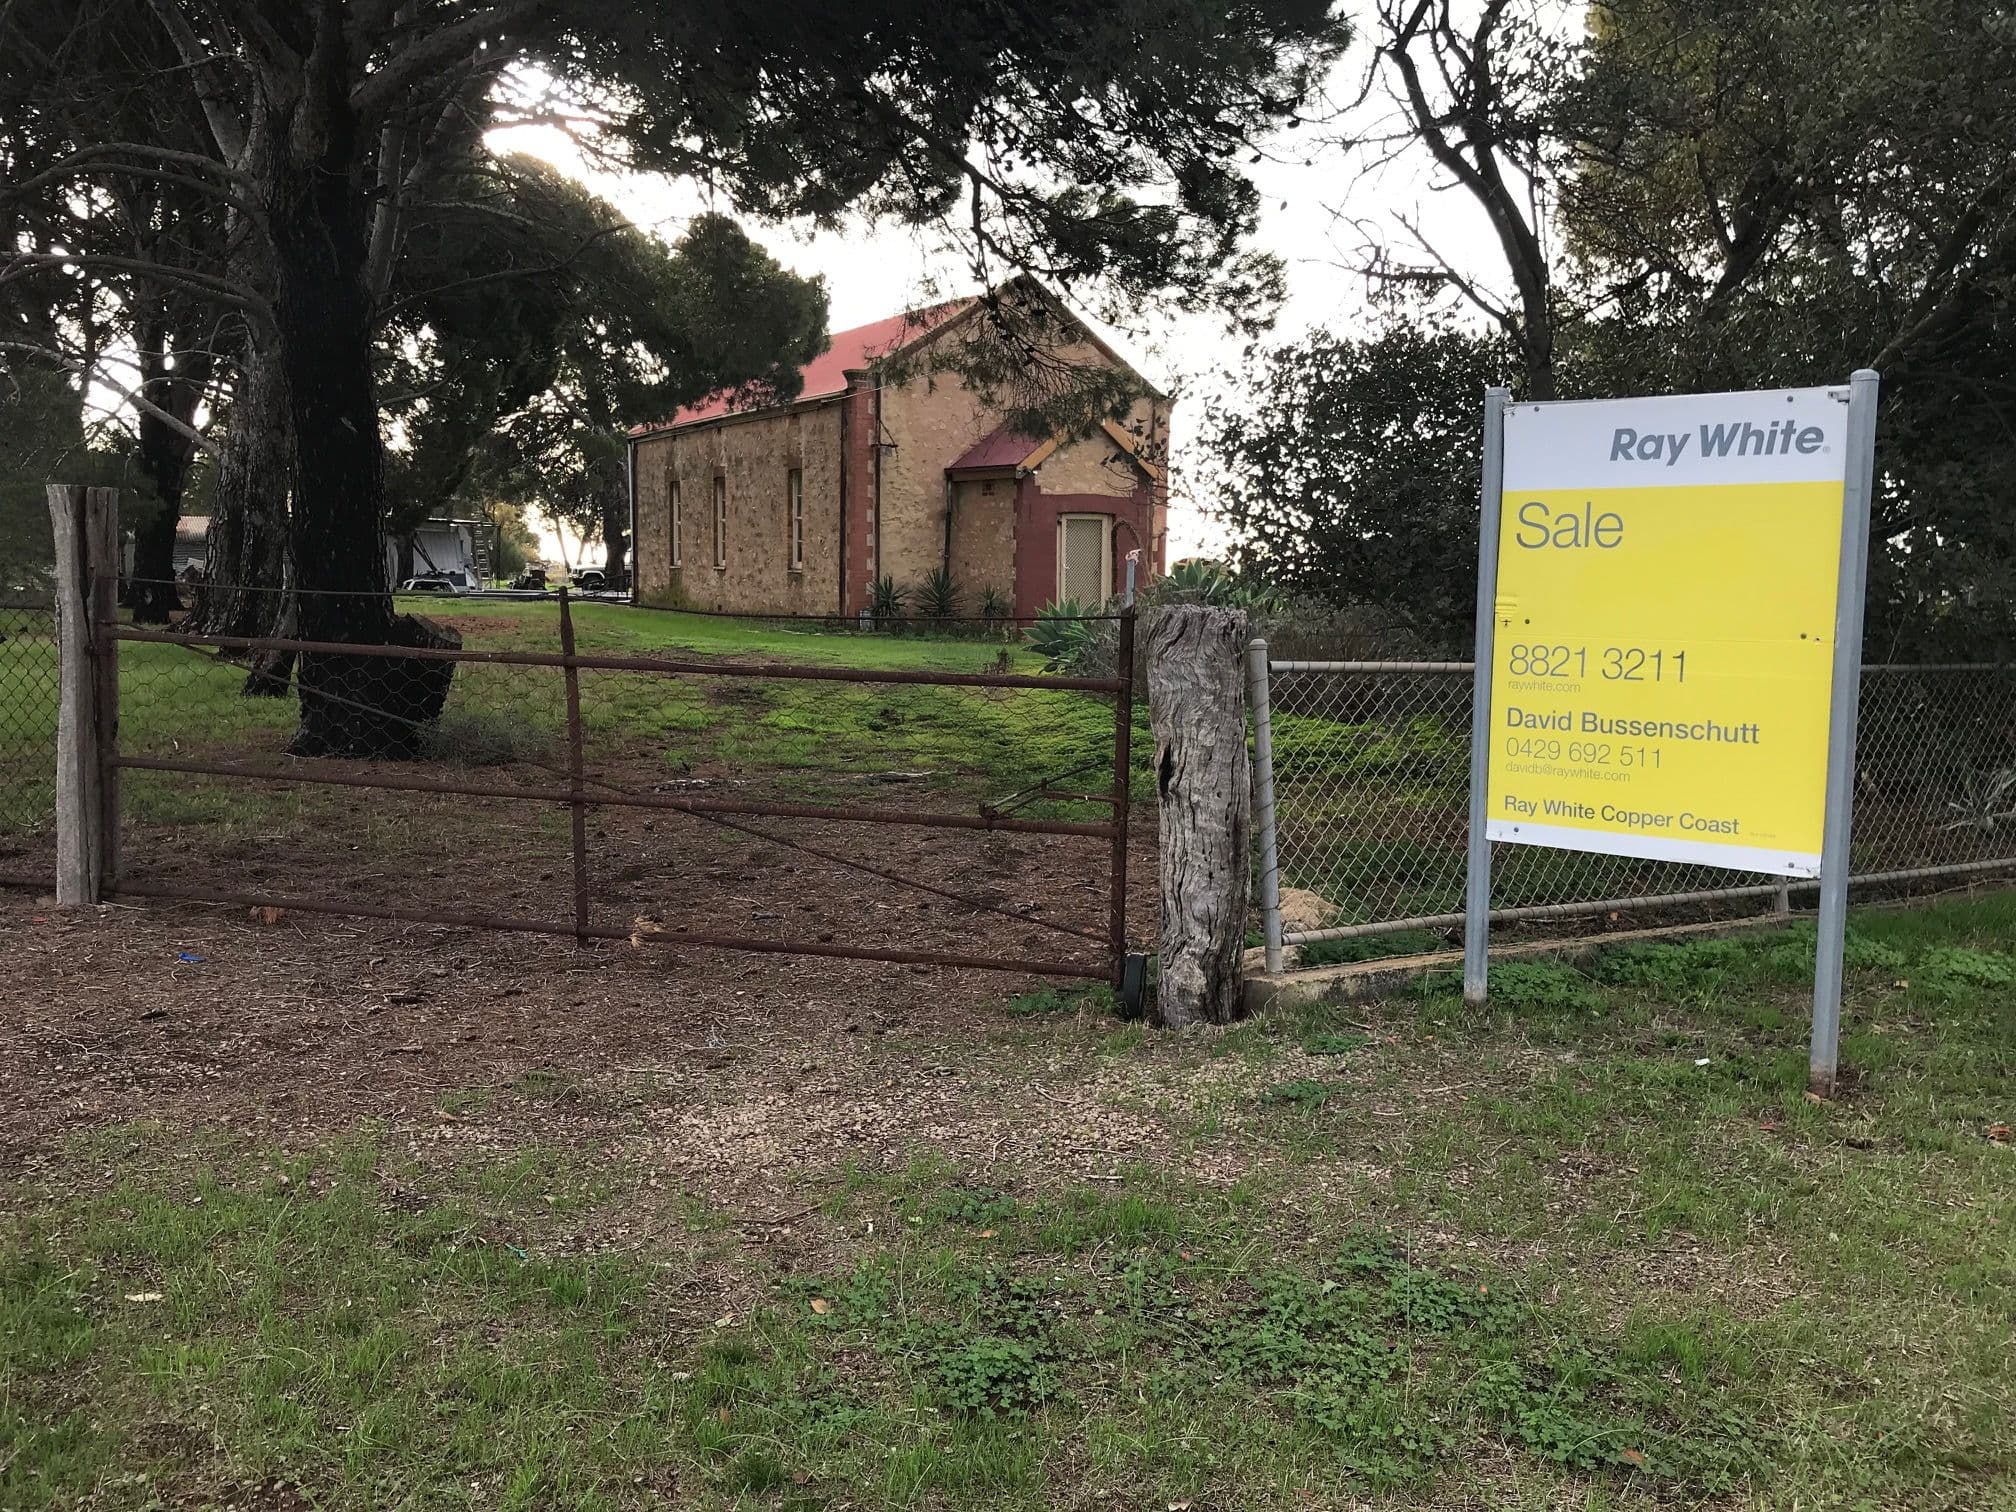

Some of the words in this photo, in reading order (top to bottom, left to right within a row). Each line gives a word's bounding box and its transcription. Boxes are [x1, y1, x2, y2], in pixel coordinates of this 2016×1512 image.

[1609, 428, 1691, 466] Ray
[1516, 501, 1624, 549] Sale
[1509, 644, 1586, 677] 8821
[1601, 647, 1686, 682] 3211
[1507, 680, 1581, 693] raywhite.com
[1506, 707, 1572, 731] David
[1581, 711, 1760, 744] Bussenschutt
[1505, 737, 1561, 760] 0429
[1568, 741, 1611, 765] 692
[1619, 746, 1661, 768] 511
[1505, 762, 1631, 782] davidb@raywhite.com
[1504, 795, 1538, 816] Ray
[1543, 799, 1596, 820] White
[1600, 804, 1674, 829] Copper
[1679, 812, 1740, 835] Coast
